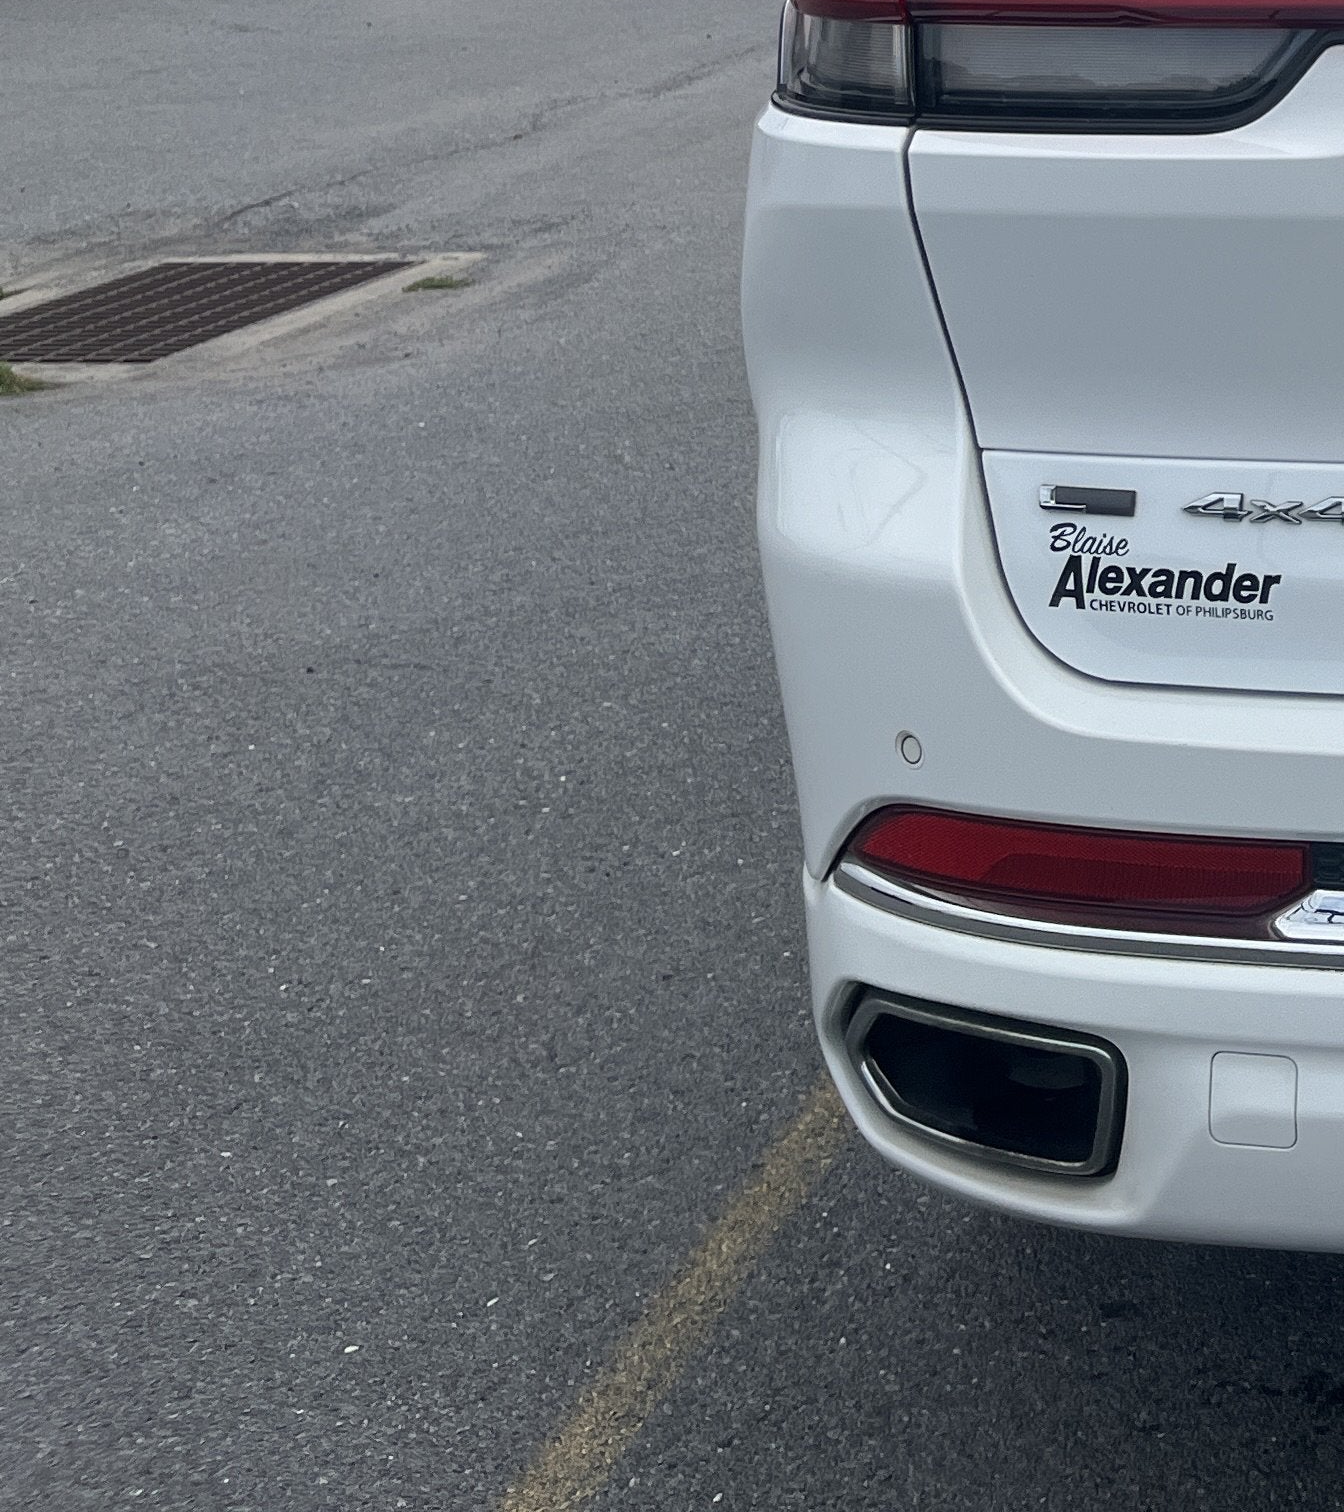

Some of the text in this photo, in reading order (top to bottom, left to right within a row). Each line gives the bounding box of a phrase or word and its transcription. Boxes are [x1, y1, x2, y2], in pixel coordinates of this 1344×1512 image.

[1048, 522, 1130, 556] Blaise
[1048, 554, 1282, 610] Alexander
[1089, 599, 1274, 621] CHEVROLET OF PHILIPSBURG
